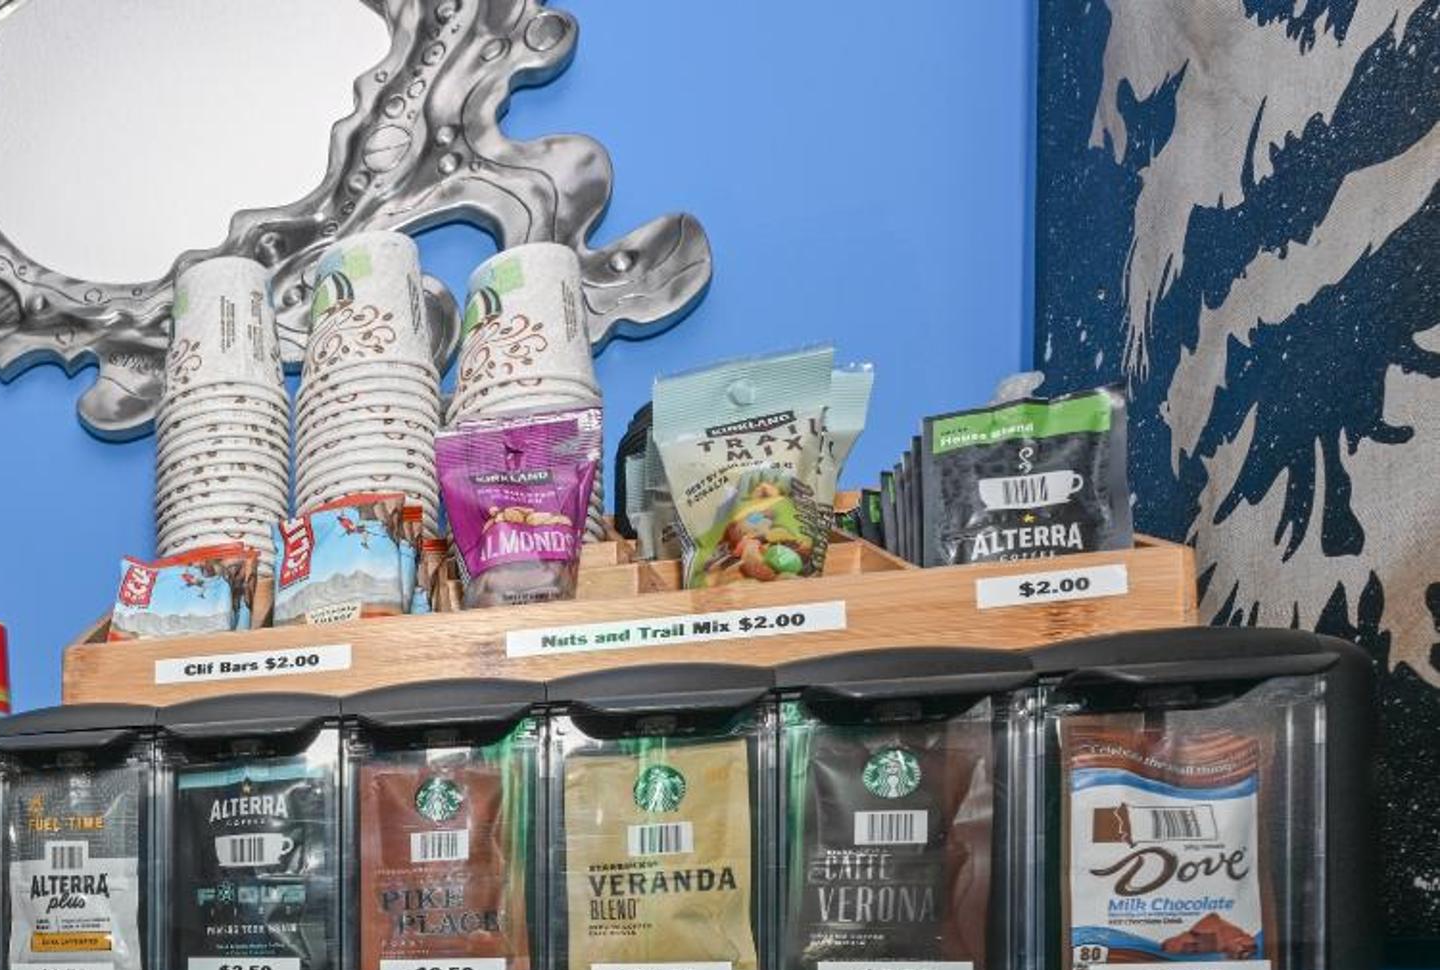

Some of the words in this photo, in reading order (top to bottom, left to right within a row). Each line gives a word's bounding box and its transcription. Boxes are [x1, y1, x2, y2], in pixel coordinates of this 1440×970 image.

[711, 413, 792, 437] KIRKLAND
[727, 436, 803, 461] MIX
[940, 430, 987, 447] House
[971, 523, 1084, 562] ALTERRA
[1019, 577, 1090, 598] $2.00
[541, 634, 588, 649] Nuts
[595, 628, 631, 643] and
[639, 623, 685, 639] Trail
[692, 620, 729, 635] Mix
[739, 613, 806, 632] $2.00
[184, 662, 214, 677] Clif
[220, 659, 259, 674] Bars
[265, 653, 320, 670] $2.00
[210, 794, 288, 823] ALTERRA
[68, 815, 105, 830] TIME
[588, 867, 738, 897] VERANDA
[1089, 846, 1249, 897] Dove
[31, 873, 110, 900] ALTERRA
[46, 891, 86, 914] plus
[380, 887, 465, 912] PIKE
[590, 899, 637, 921] BLEND
[818, 886, 936, 923] VERONA
[1108, 898, 1147, 911] Milk
[1151, 896, 1234, 911] Chocolate
[398, 911, 501, 935] PLACE
[1079, 947, 1101, 961] 80
